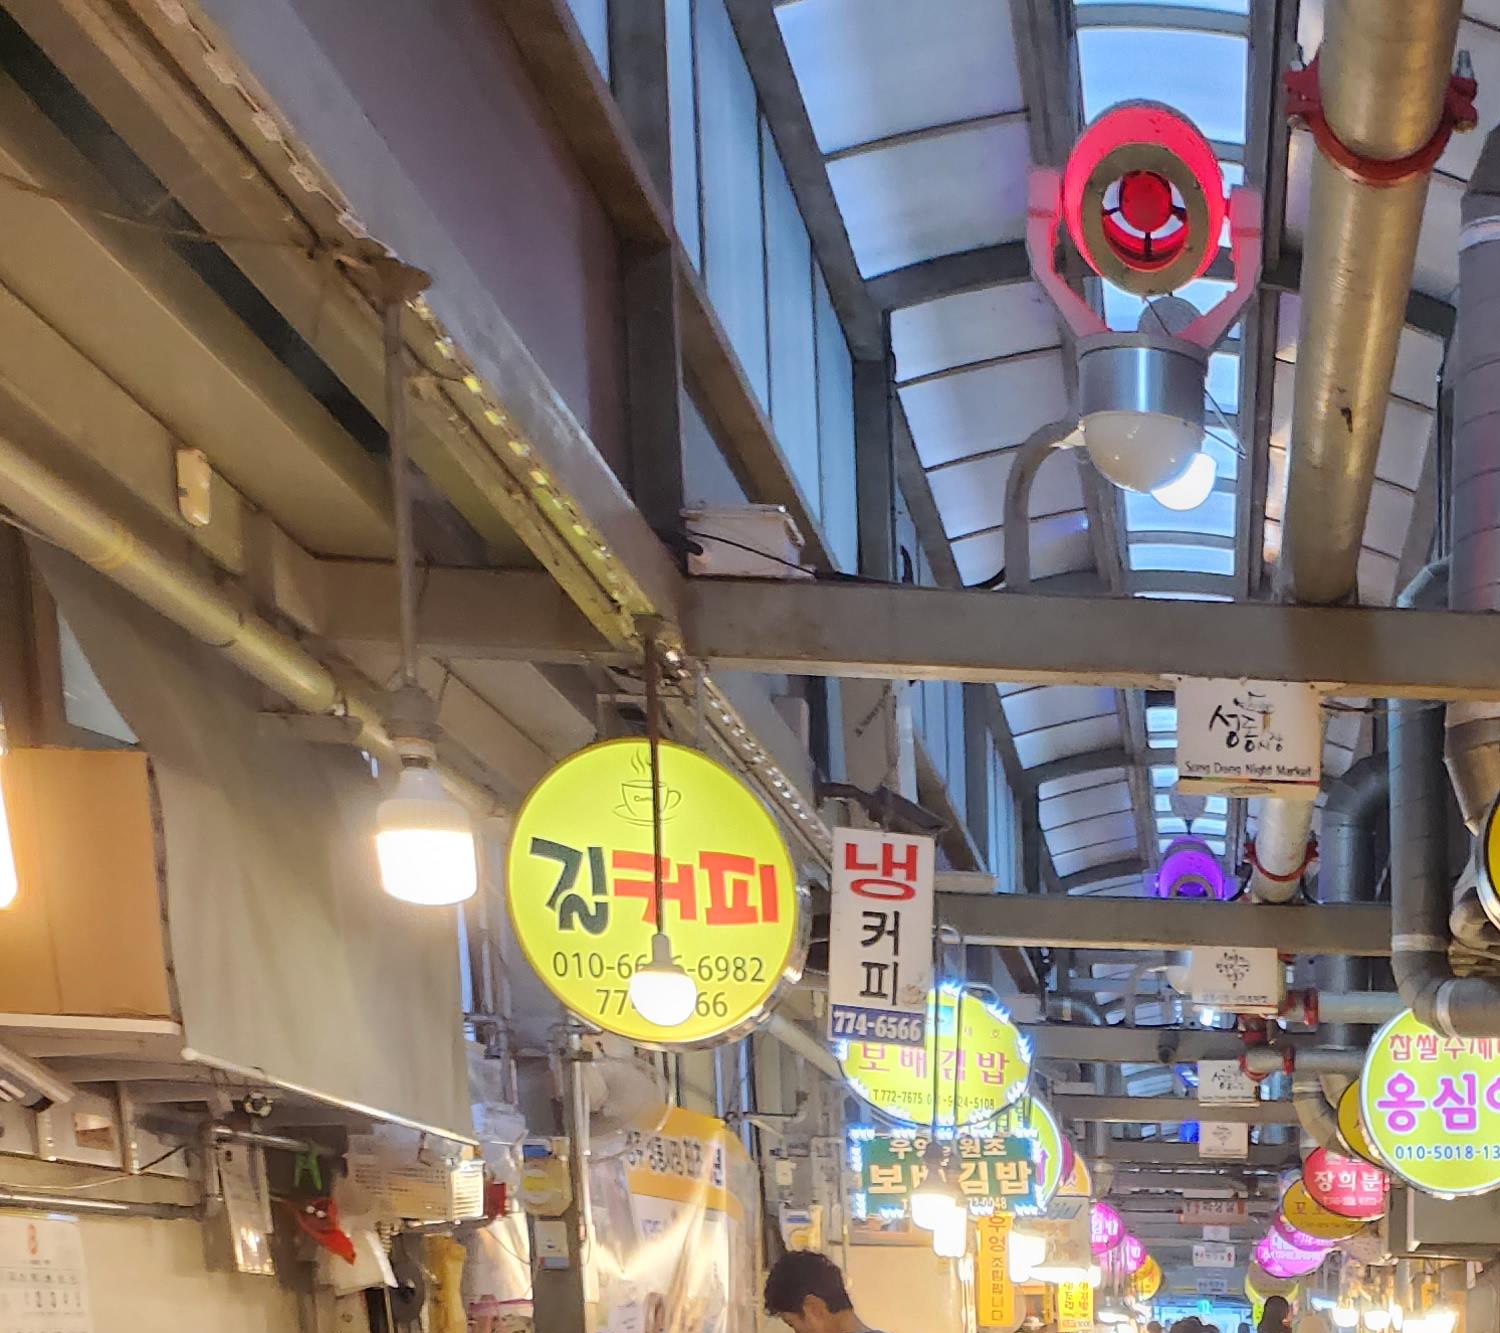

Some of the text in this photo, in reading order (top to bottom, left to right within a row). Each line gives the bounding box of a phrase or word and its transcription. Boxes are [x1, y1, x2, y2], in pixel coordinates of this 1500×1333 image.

[844, 841, 919, 1006] 냉커피
[833, 1009, 923, 1042] 774-6566
[1314, 1170, 1389, 1193] 장희분
